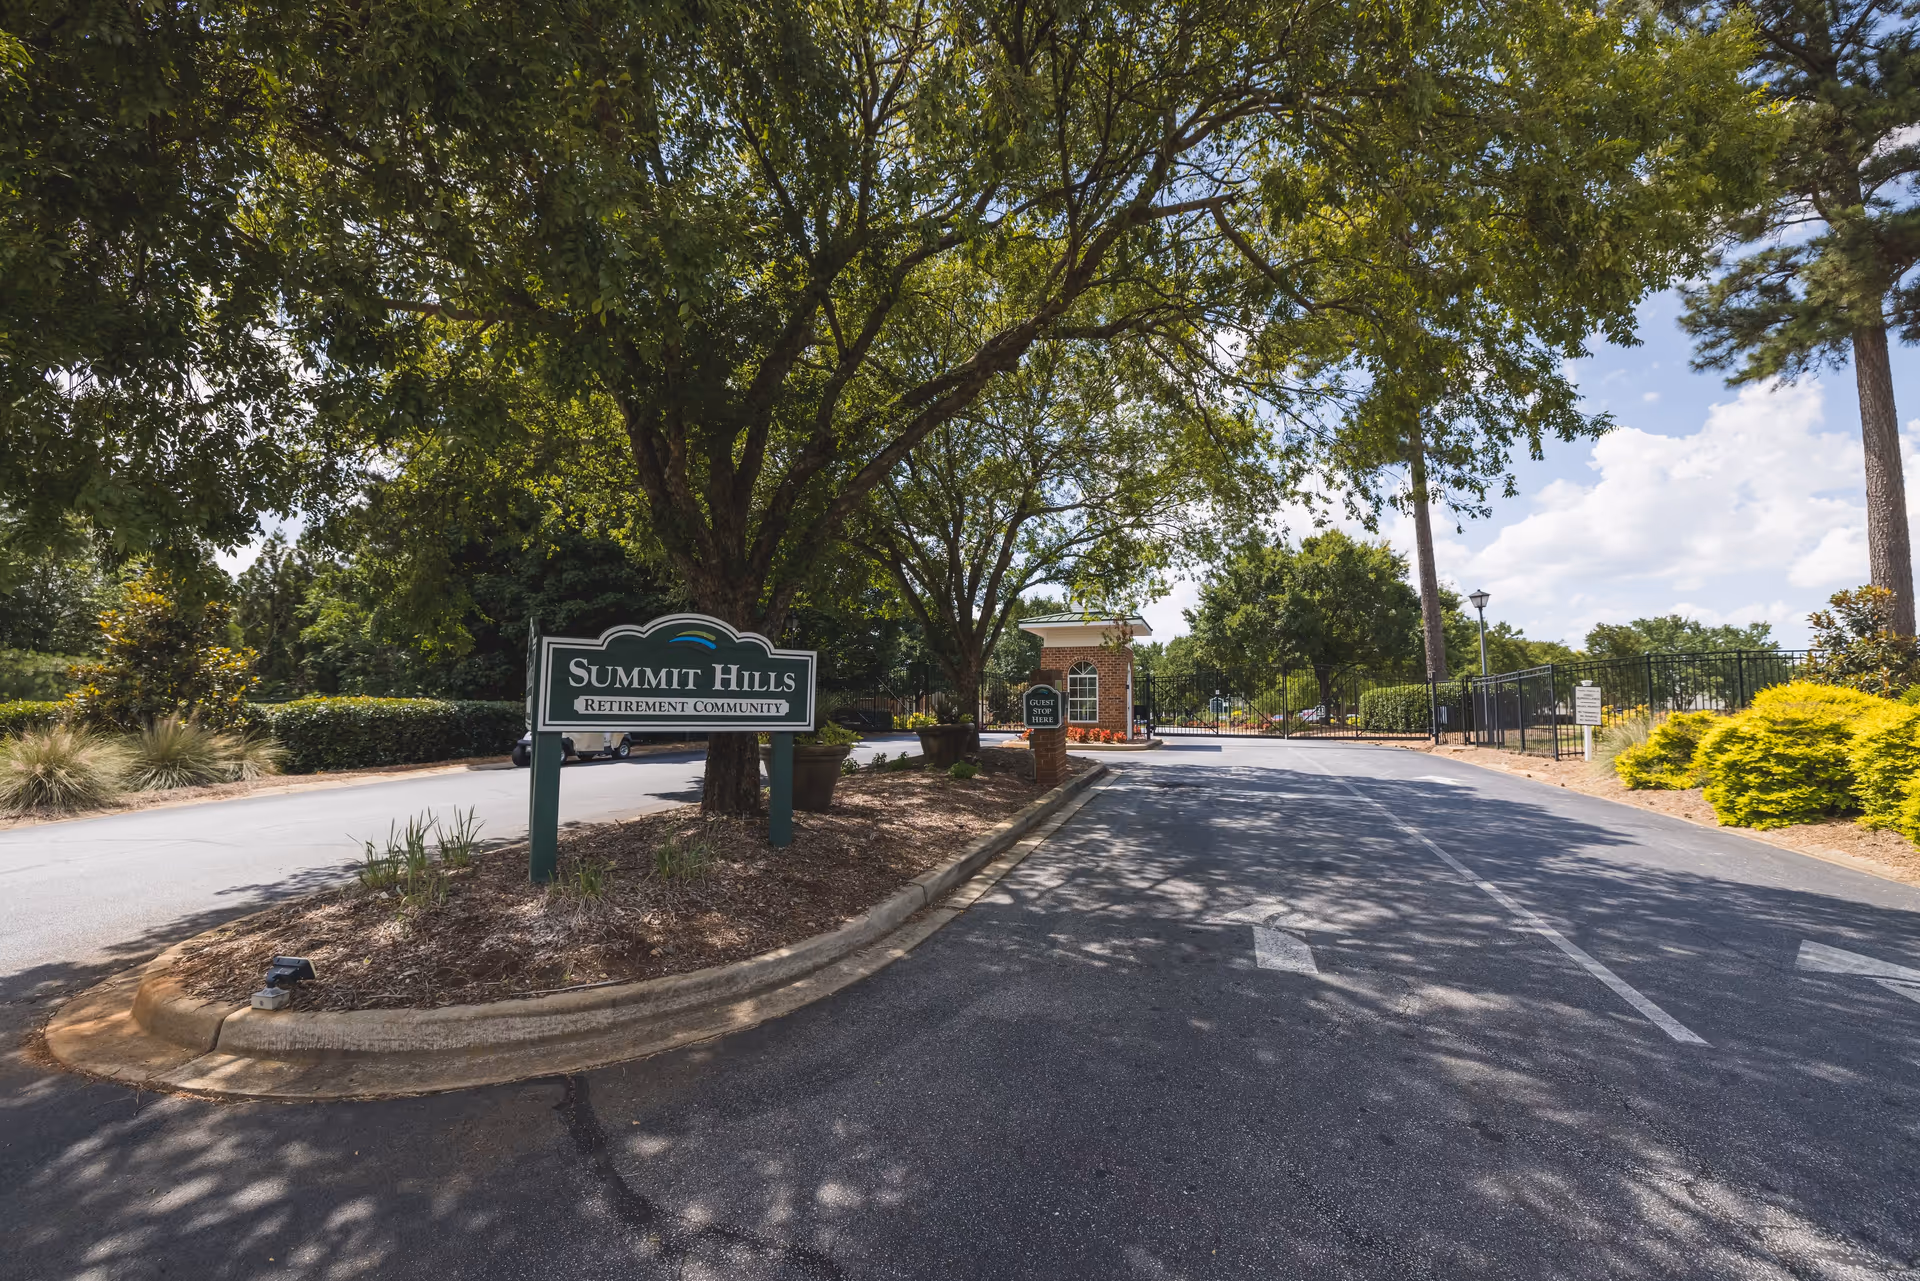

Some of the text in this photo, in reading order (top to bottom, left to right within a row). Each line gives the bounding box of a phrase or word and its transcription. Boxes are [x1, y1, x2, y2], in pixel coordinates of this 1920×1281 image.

[568, 657, 796, 692] SUMMIT HILLS
[583, 698, 783, 713] RETIREMENT COMMUNITY
[1032, 707, 1052, 715] STOP
[1031, 715, 1054, 723] HERE
